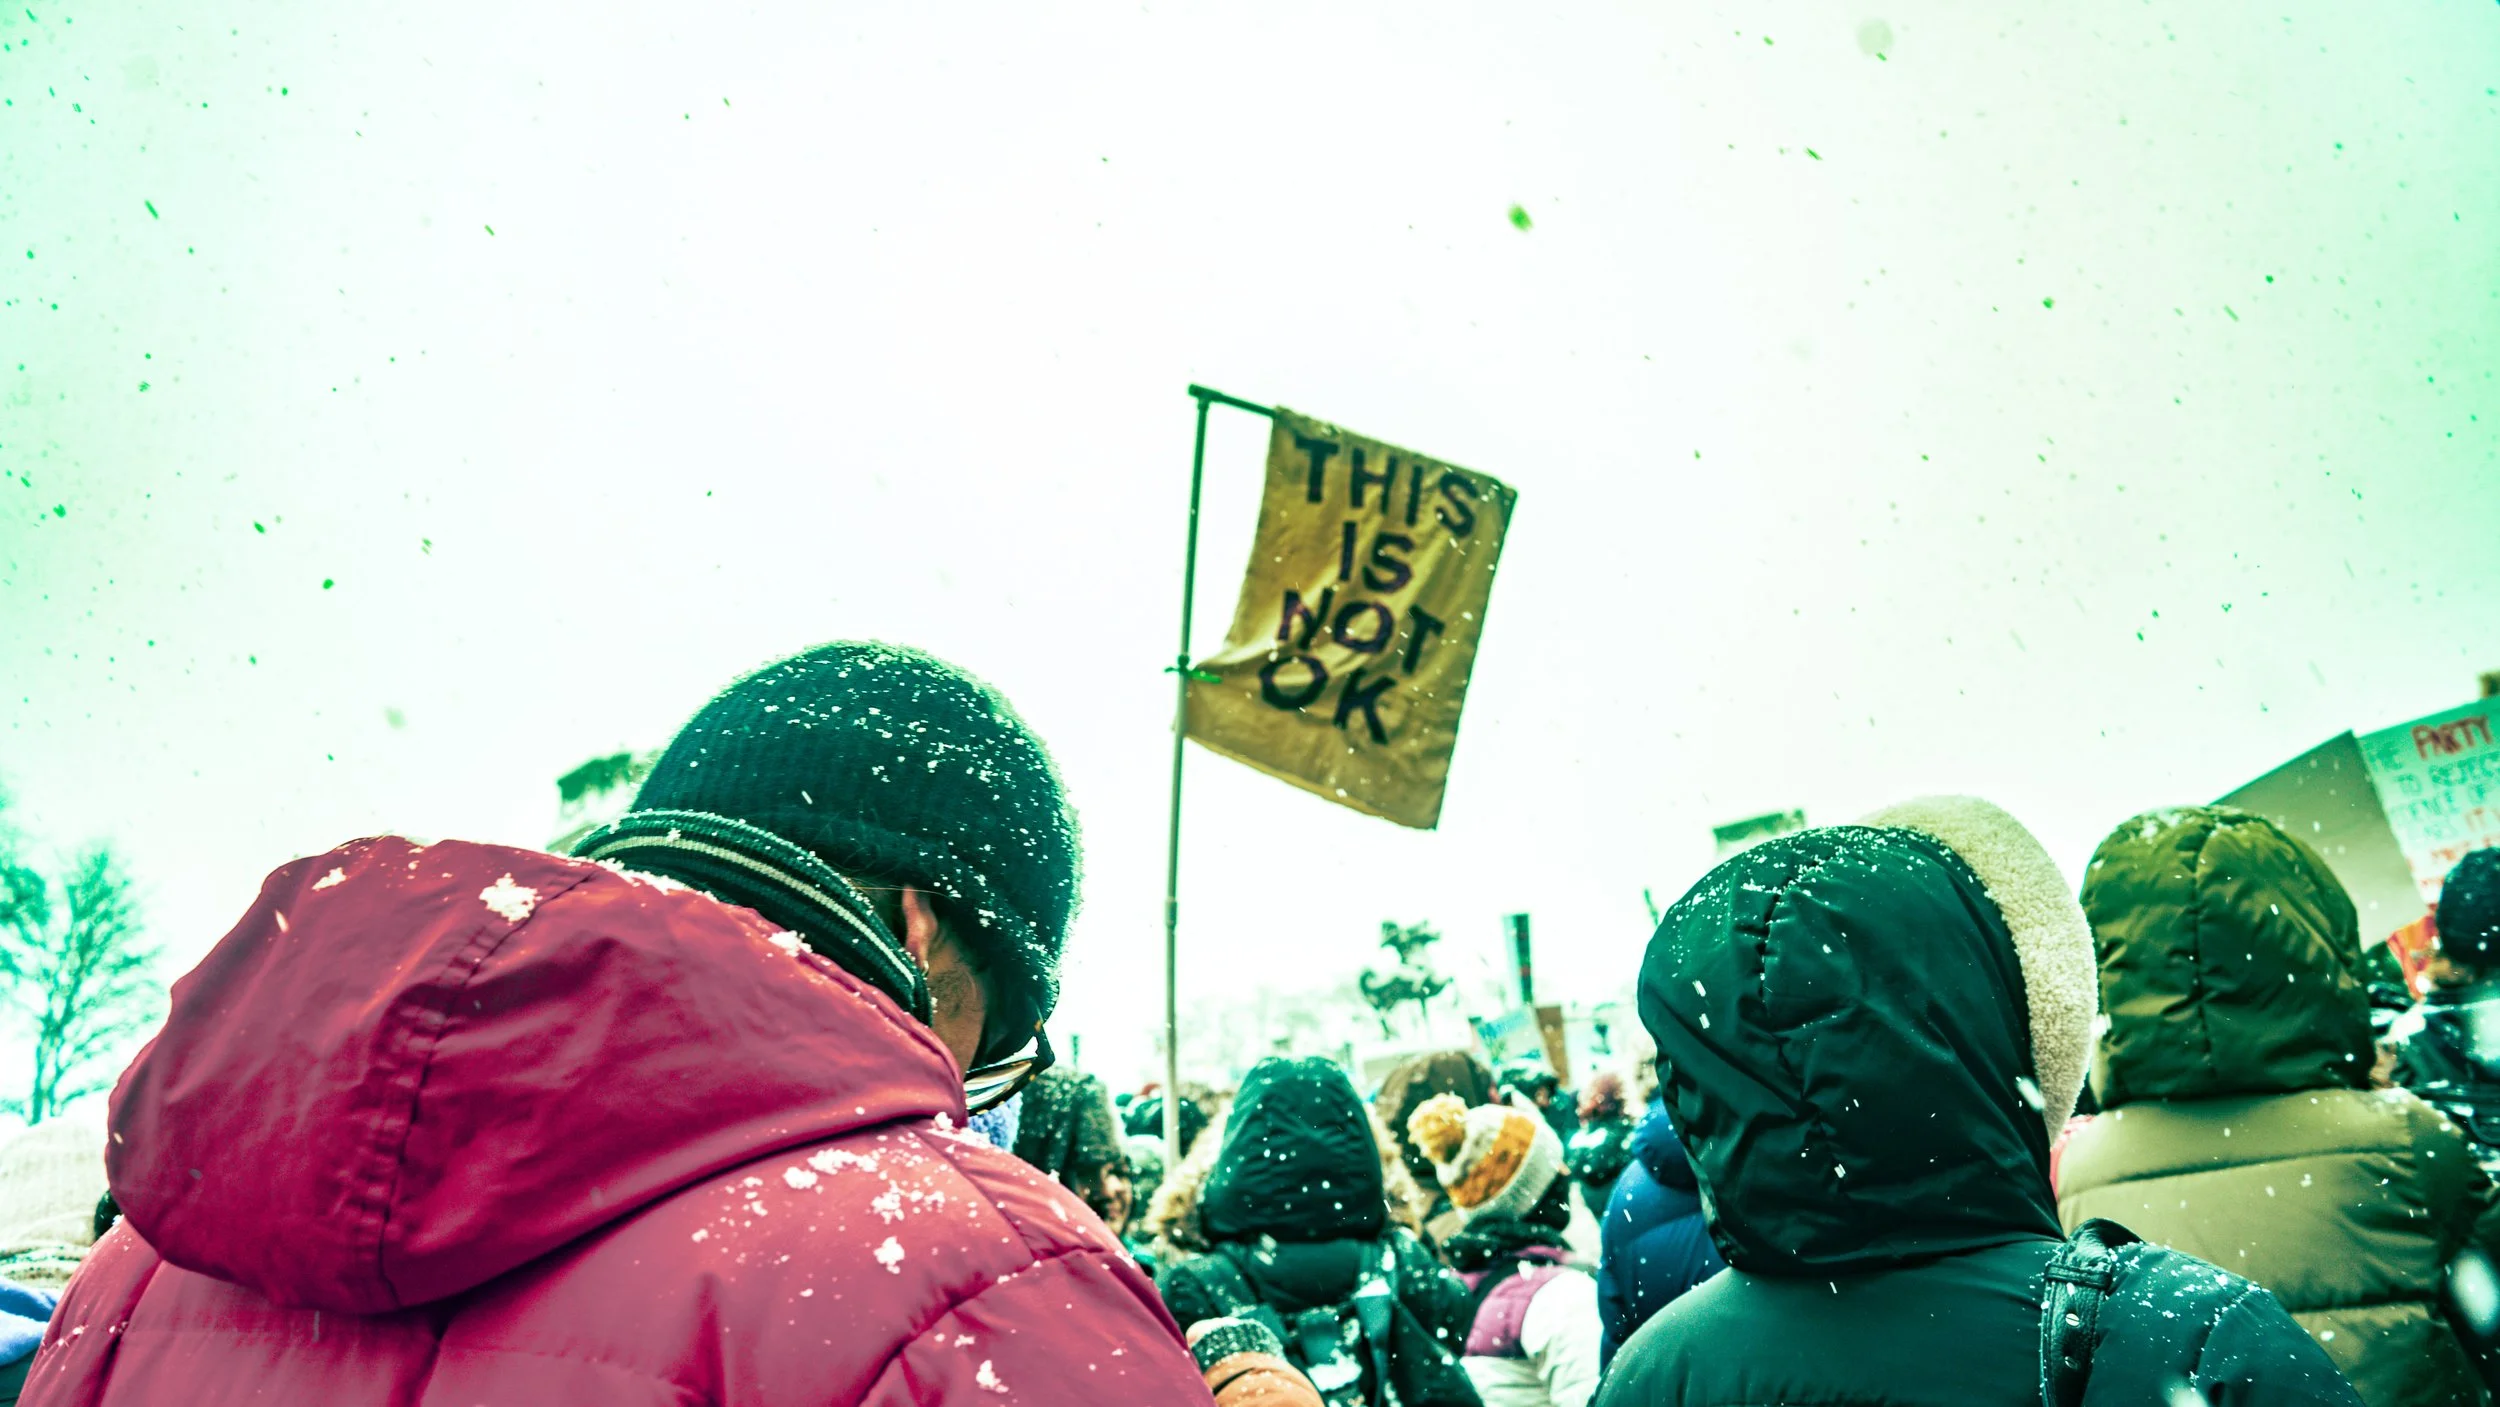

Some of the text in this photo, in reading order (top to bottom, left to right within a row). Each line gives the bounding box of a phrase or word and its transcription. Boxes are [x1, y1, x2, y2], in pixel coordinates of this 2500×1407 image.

[1295, 437, 1479, 538] THIS
[1339, 521, 1413, 594] IS
[1279, 587, 1445, 675] NOT
[1259, 655, 1396, 746] OK
[2410, 714, 2493, 761] PARTY
